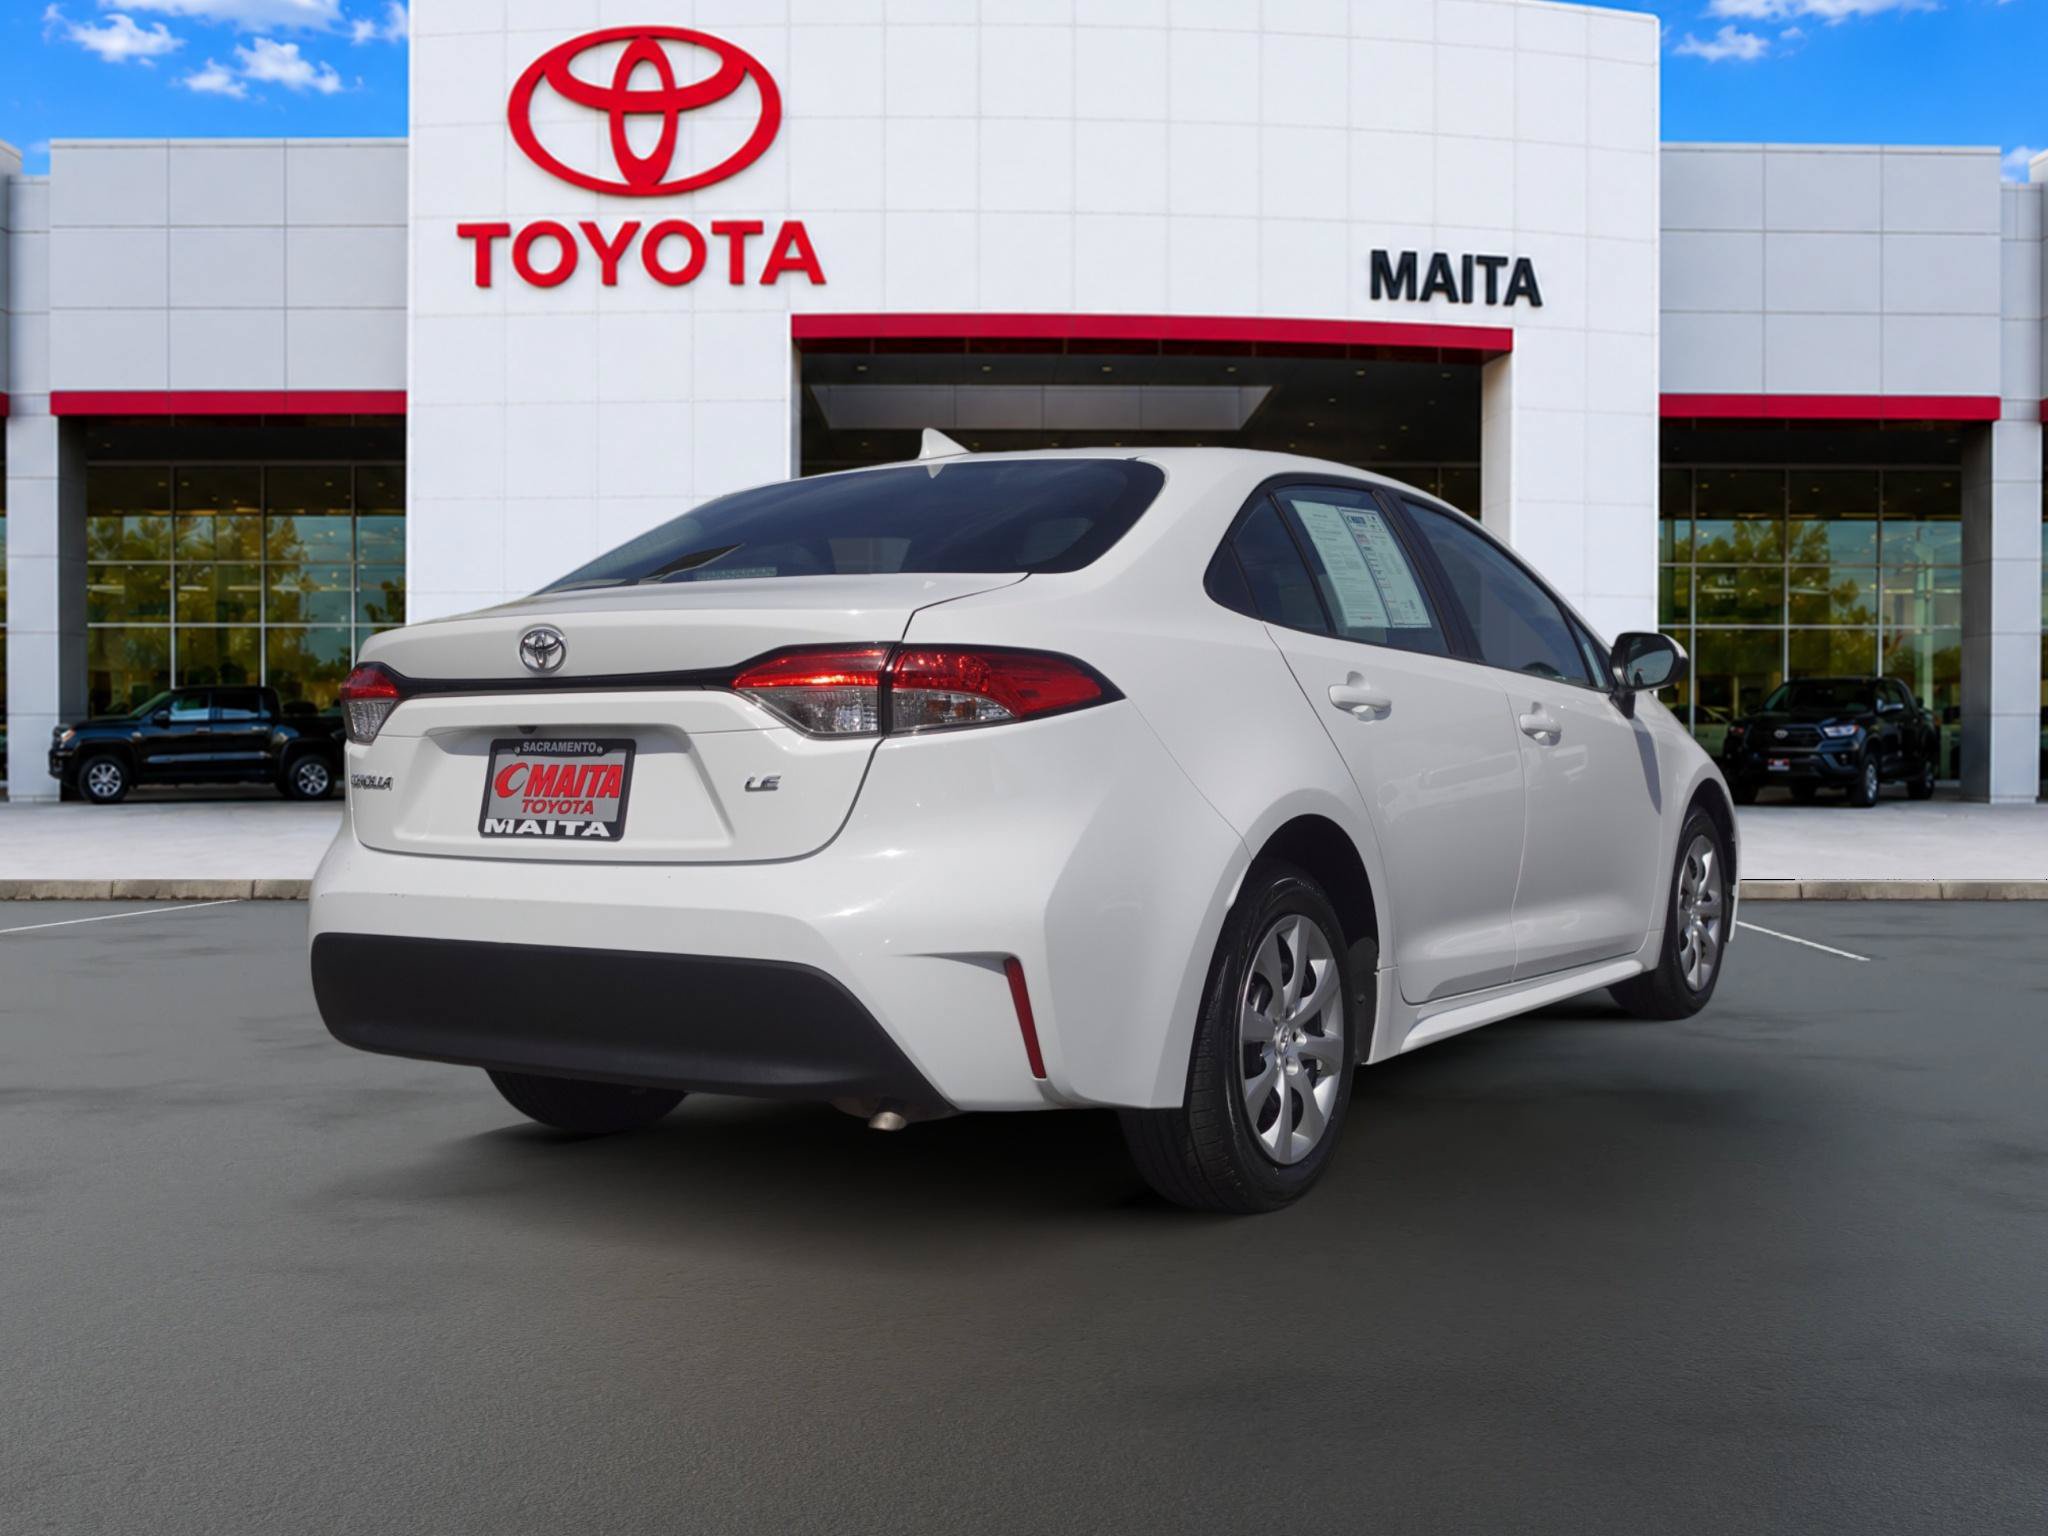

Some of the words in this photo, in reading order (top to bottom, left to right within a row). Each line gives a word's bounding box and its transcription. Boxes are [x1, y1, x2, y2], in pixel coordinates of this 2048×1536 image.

[457, 220, 826, 288] TOYOTA
[1370, 250, 1543, 307] MAITA
[522, 742, 597, 753] SACRAMENTO
[744, 775, 782, 792] LE
[521, 799, 595, 815] TOYOTA
[483, 818, 611, 837] MAITA
